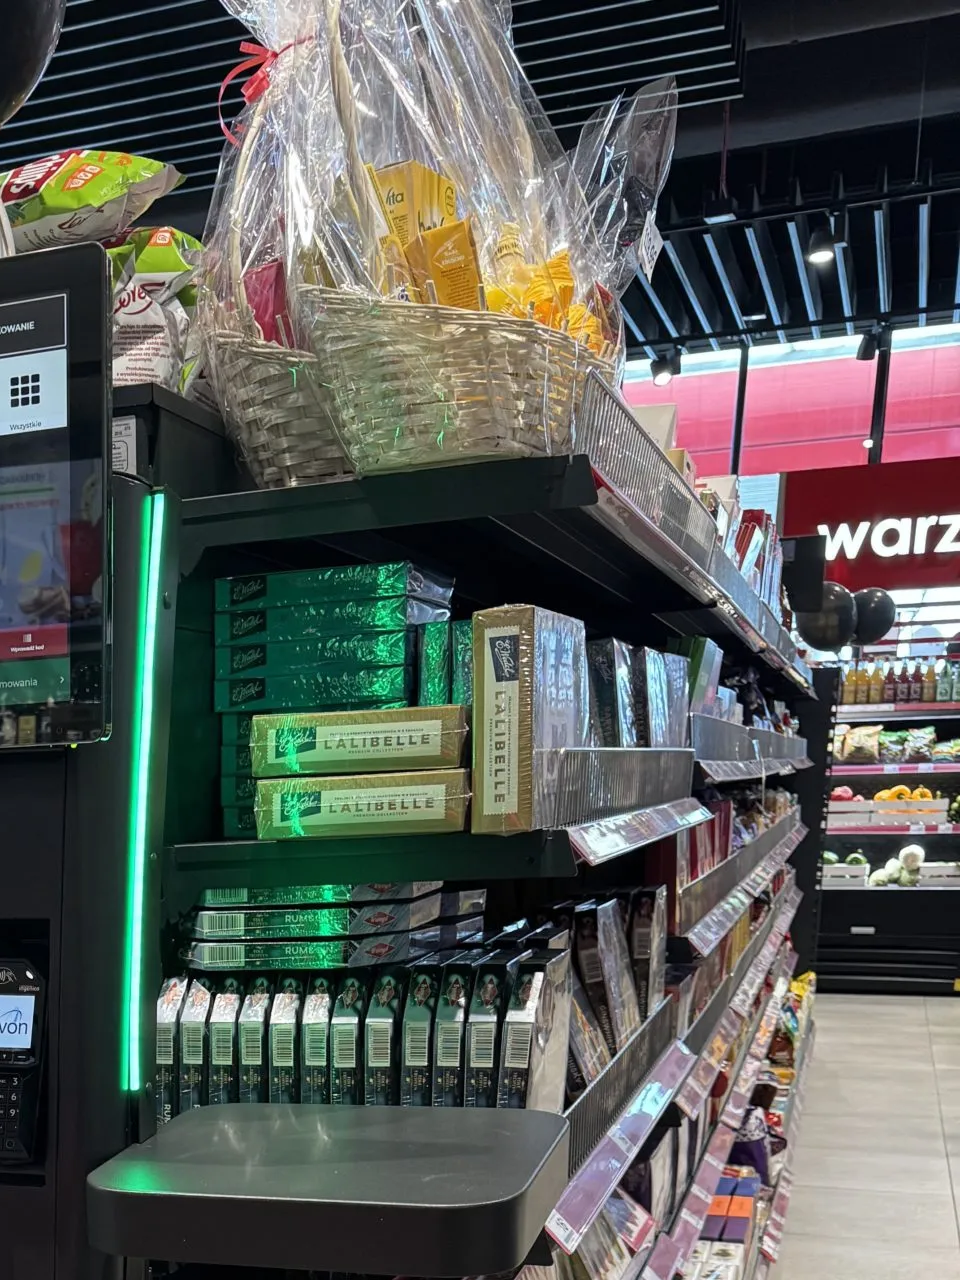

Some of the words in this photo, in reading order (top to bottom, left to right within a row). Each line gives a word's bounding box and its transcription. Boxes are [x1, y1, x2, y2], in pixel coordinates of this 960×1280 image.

[9, 420, 42, 431] Wszystkie
[817, 512, 960, 560] warz
[324, 733, 430, 750] LALIBELLE
[494, 691, 506, 803] LALIBELLE
[329, 797, 435, 814] LALIBELLE
[13, 1077, 18, 1085] 3
[11, 1092, 17, 1101] 6
[9, 1109, 16, 1117] 9
